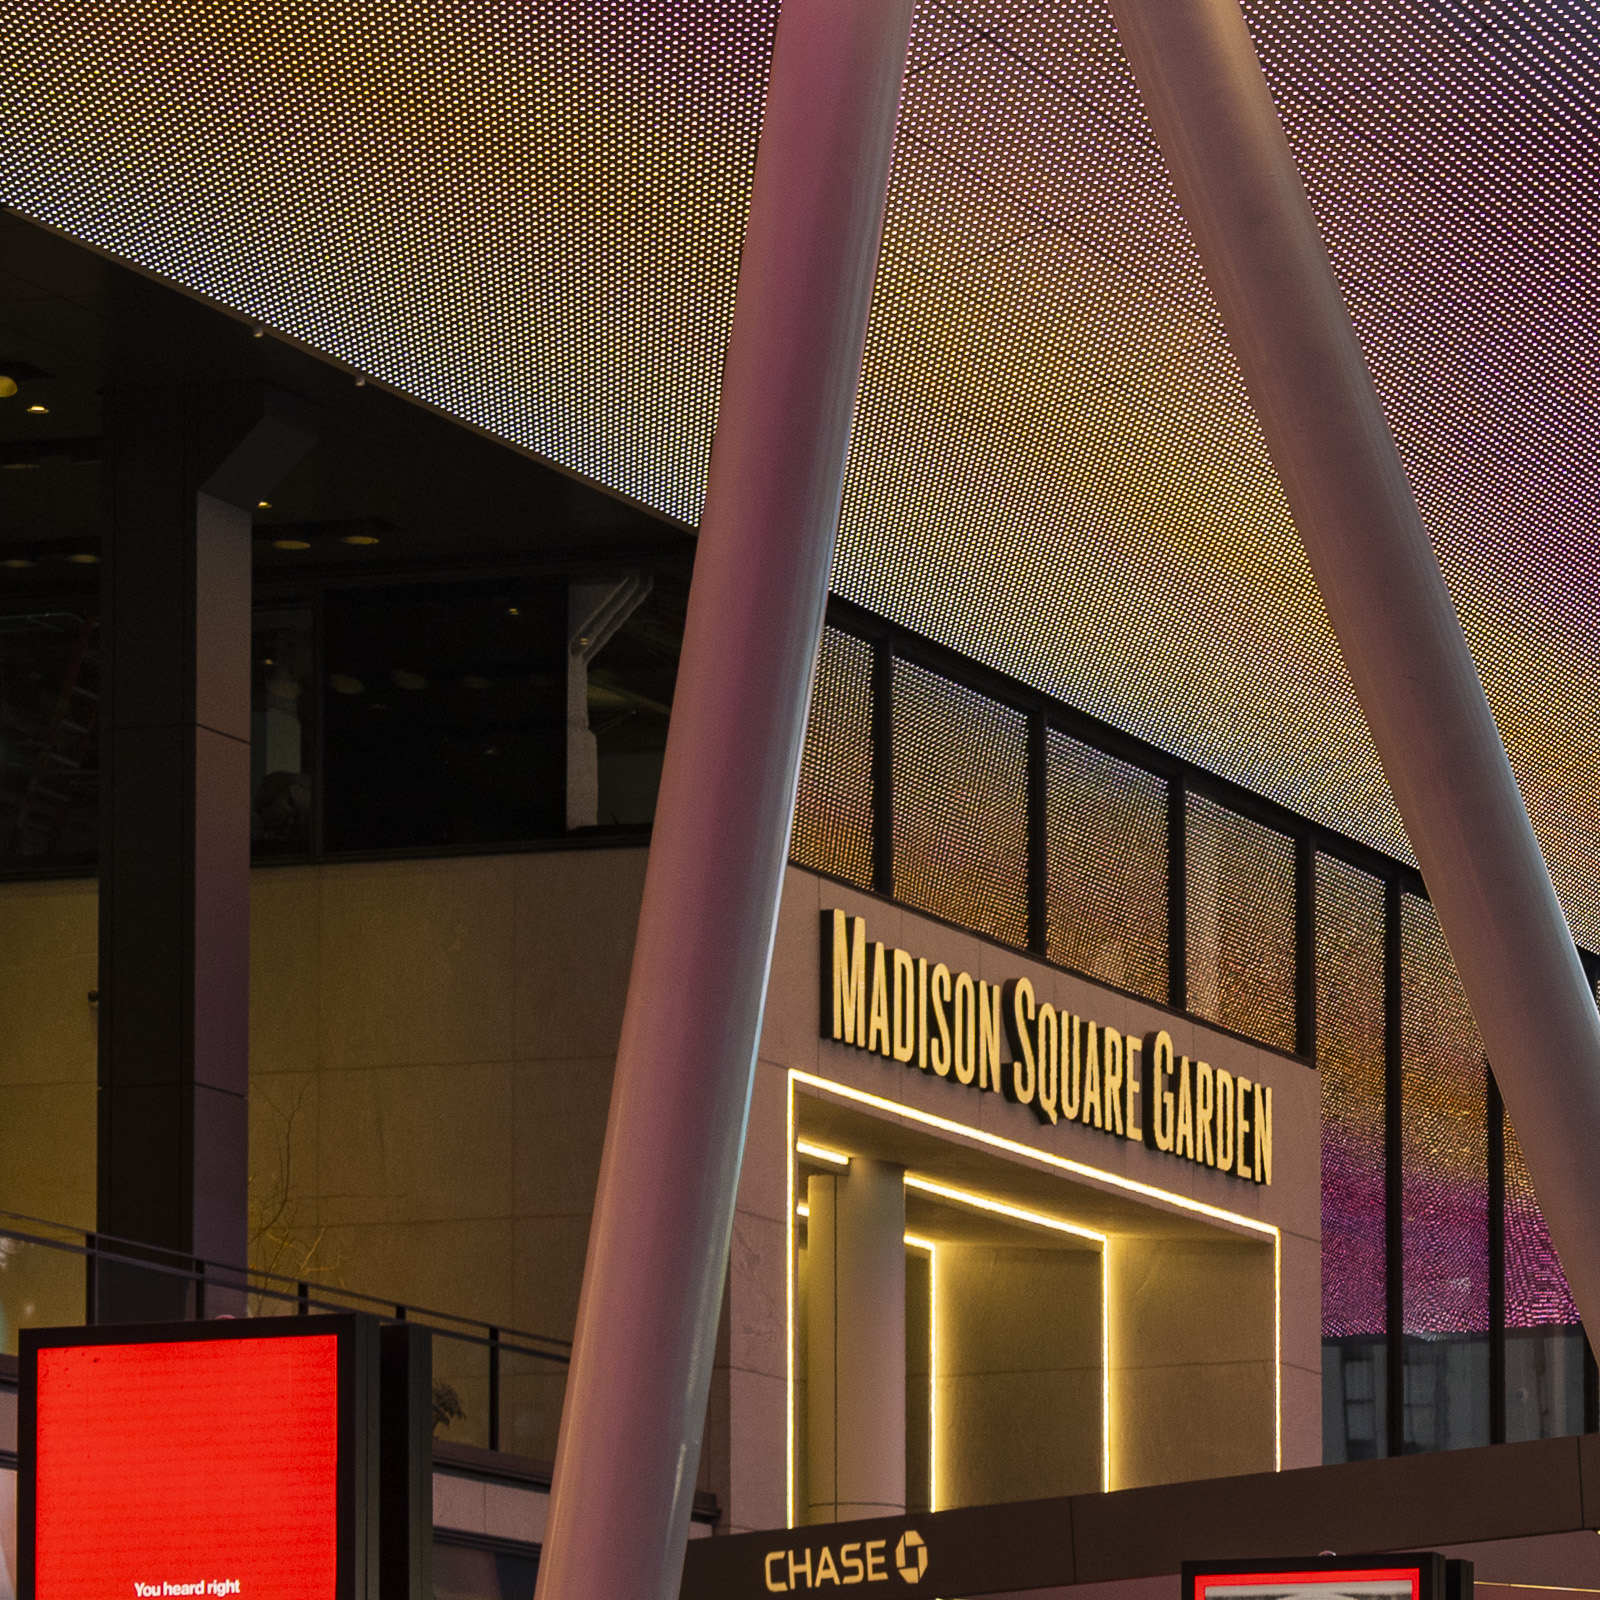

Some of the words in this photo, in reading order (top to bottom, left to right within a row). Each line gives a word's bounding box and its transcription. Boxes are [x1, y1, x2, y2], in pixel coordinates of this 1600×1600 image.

[833, 908, 1001, 1094] MADISON
[1012, 976, 1142, 1142] SQUARE
[1153, 1029, 1272, 1186] GARDEN
[134, 1581, 161, 1598] You
[163, 1579, 205, 1596] heard
[207, 1578, 240, 1597] right
[764, 1538, 888, 1593] CHASE
